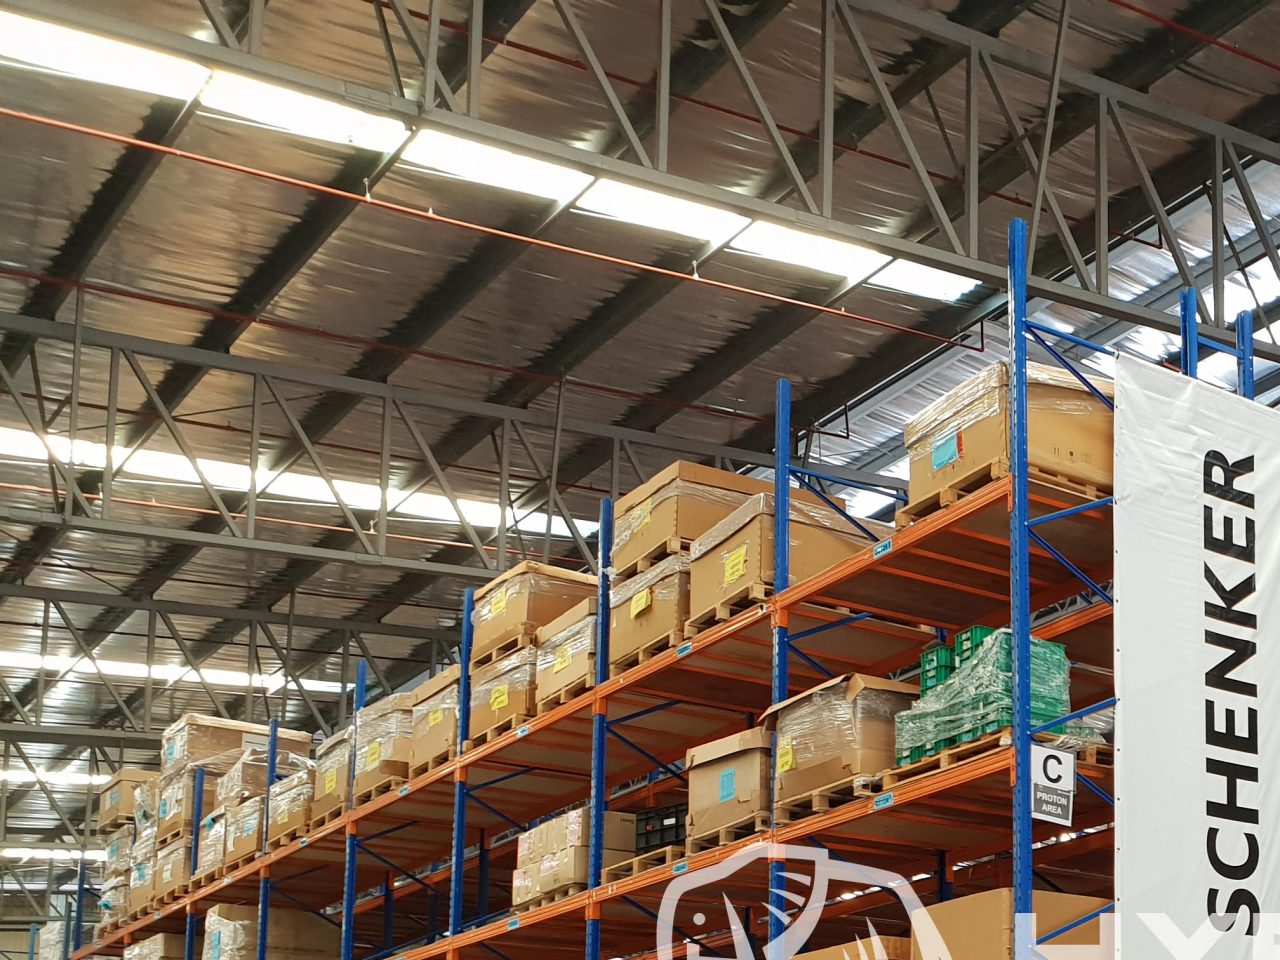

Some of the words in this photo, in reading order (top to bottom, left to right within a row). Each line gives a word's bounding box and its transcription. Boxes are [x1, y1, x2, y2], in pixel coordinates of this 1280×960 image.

[1202, 449, 1260, 937] SCHENKER
[1042, 754, 1063, 784] C
[1036, 791, 1068, 806] PROTON
[1041, 803, 1063, 816] AREA
